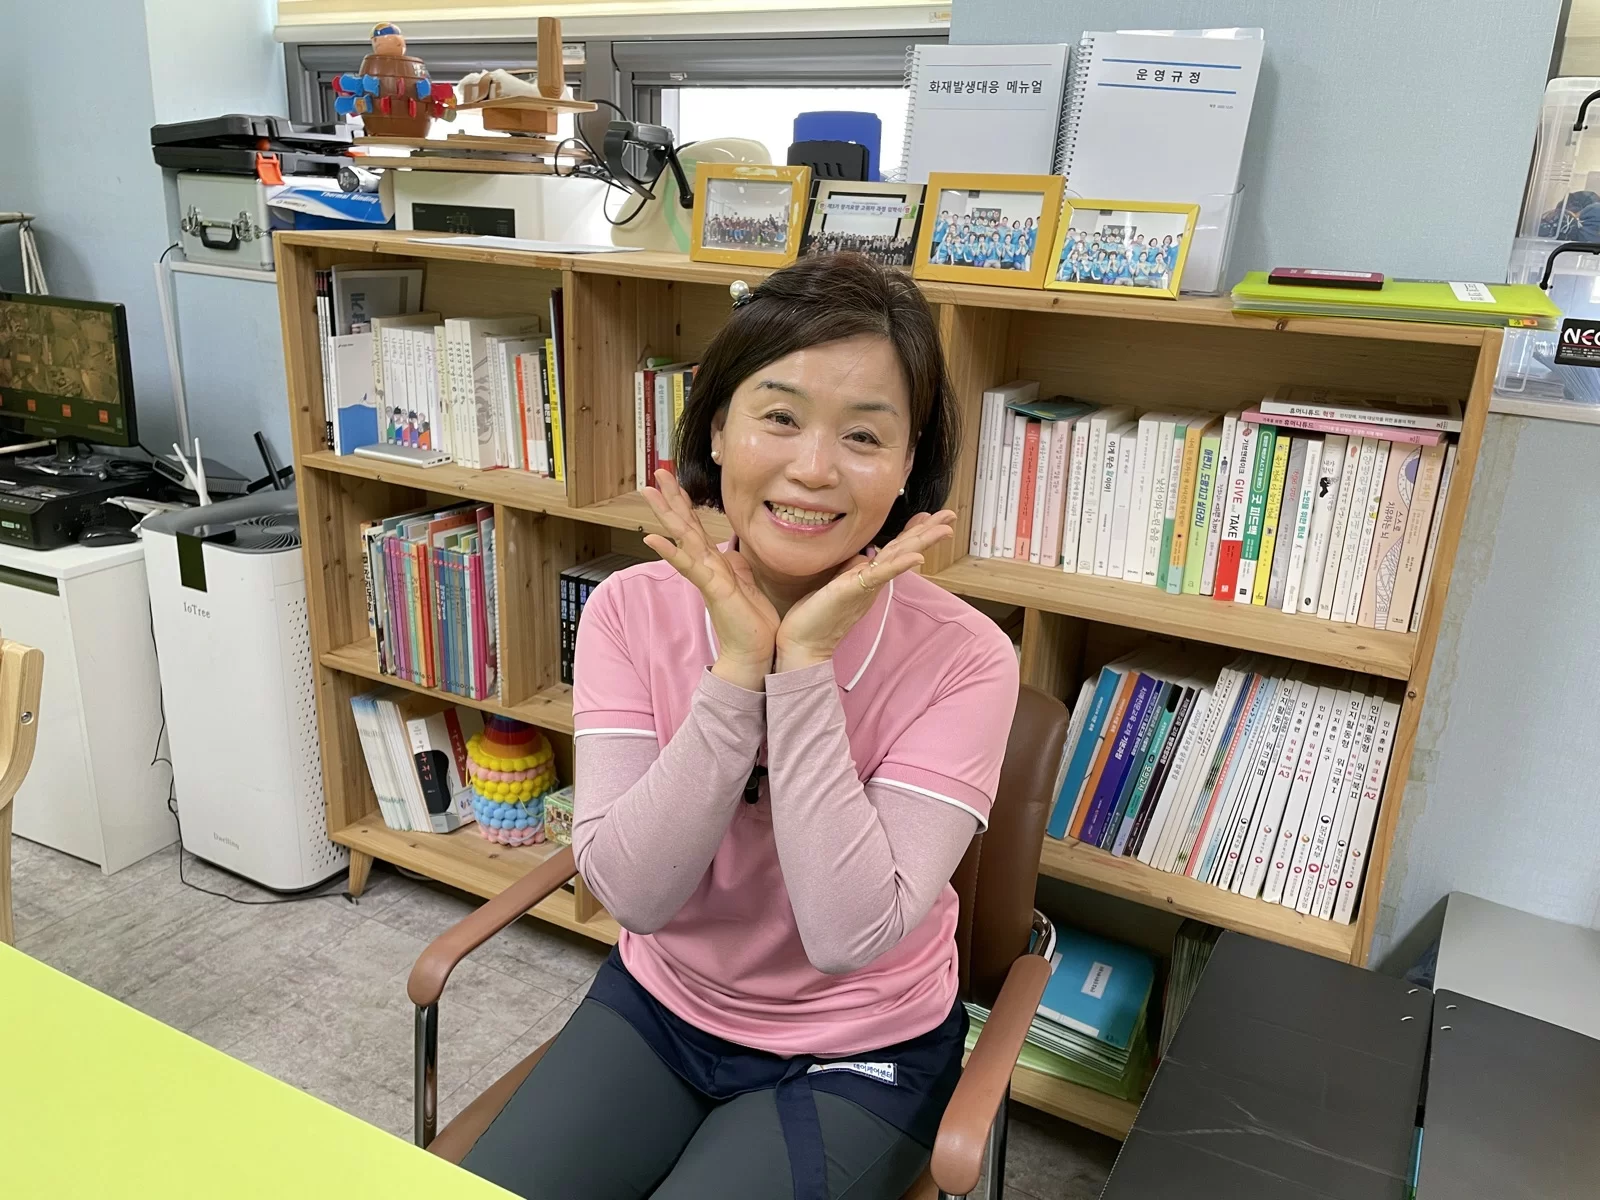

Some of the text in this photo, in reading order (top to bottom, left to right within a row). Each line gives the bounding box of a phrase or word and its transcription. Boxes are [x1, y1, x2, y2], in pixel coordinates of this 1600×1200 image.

[929, 80, 1043, 94] 화재발생대응 메뉴얼
[1136, 68, 1201, 84] 운영규정
[320, 191, 350, 201] Thermal
[1289, 407, 1320, 416] 휴머니튜드
[1284, 419, 1314, 429] 휴머니튜드
[1107, 440, 1115, 454] 이게
[1237, 438, 1249, 474] 기브앤테이크
[1106, 455, 1114, 468] 무슨
[1232, 477, 1244, 503] GIVE
[1227, 513, 1239, 538] TAKE
[1246, 505, 1260, 535] 피드백
[1379, 501, 1394, 539] 치유하는 뇌
[1392, 510, 1403, 531] 스스로
[1173, 697, 1189, 726] 치매전문교육
[1189, 708, 1202, 728] 2020년
[1270, 686, 1291, 733] 인지활동형
[1113, 685, 1147, 760] 치매전문교육 교재 기본과정
[1169, 725, 1179, 736] 교재
[1285, 700, 1307, 761] 인지훈련 워크북
[1322, 708, 1341, 761] 인지훈련 도구
[1340, 700, 1359, 748] 인지활동형
[1360, 705, 1379, 752] 인지활동형
[1181, 727, 1195, 751] 장기요양
[1303, 705, 1325, 765] 인지훈련 워크북
[1370, 720, 1389, 782] 인지훈련 워크북
[1136, 764, 1152, 791] 모의고사
[1277, 769, 1290, 778] A3
[1297, 774, 1308, 782] A1
[1363, 791, 1376, 800] A2
[852, 1063, 893, 1080] 데이케어센터
